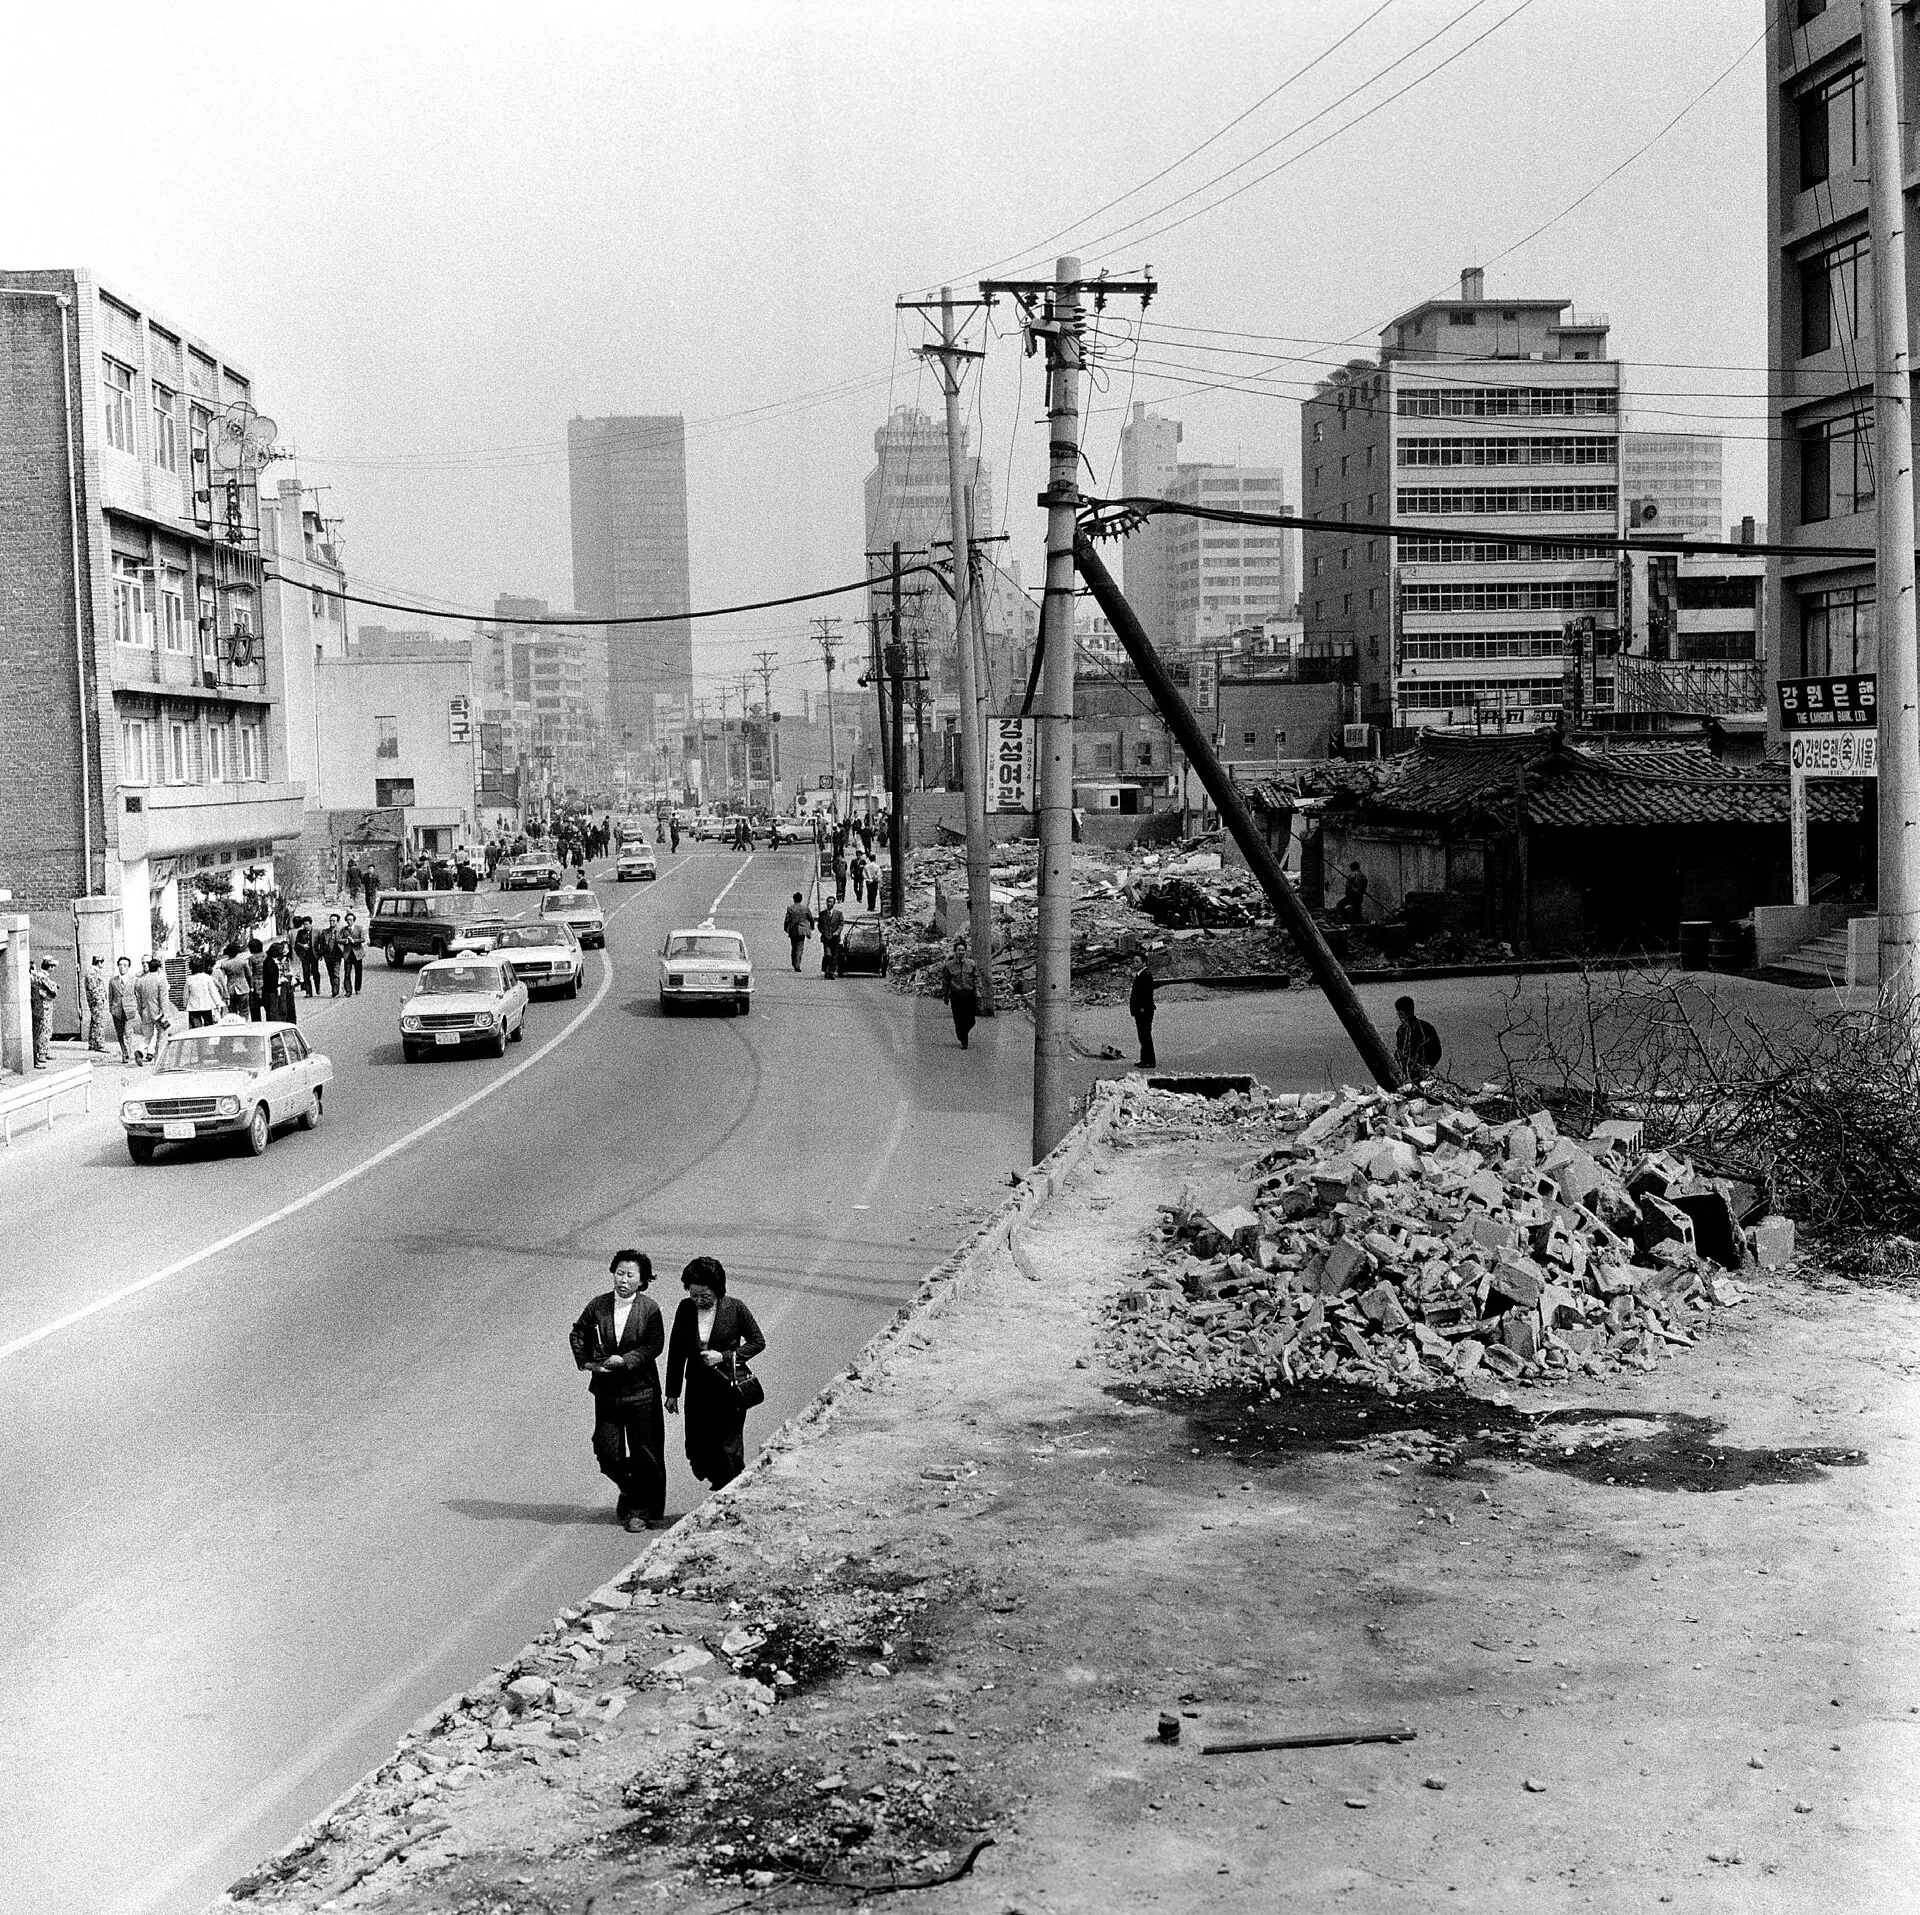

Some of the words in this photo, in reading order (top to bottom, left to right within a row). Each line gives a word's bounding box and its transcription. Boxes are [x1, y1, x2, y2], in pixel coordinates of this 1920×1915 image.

[1782, 681, 1875, 709] 강원은행
[450, 694, 470, 740] 탁구
[997, 718, 1024, 806] 경성여관
[1805, 738, 1838, 769] 강원은행
